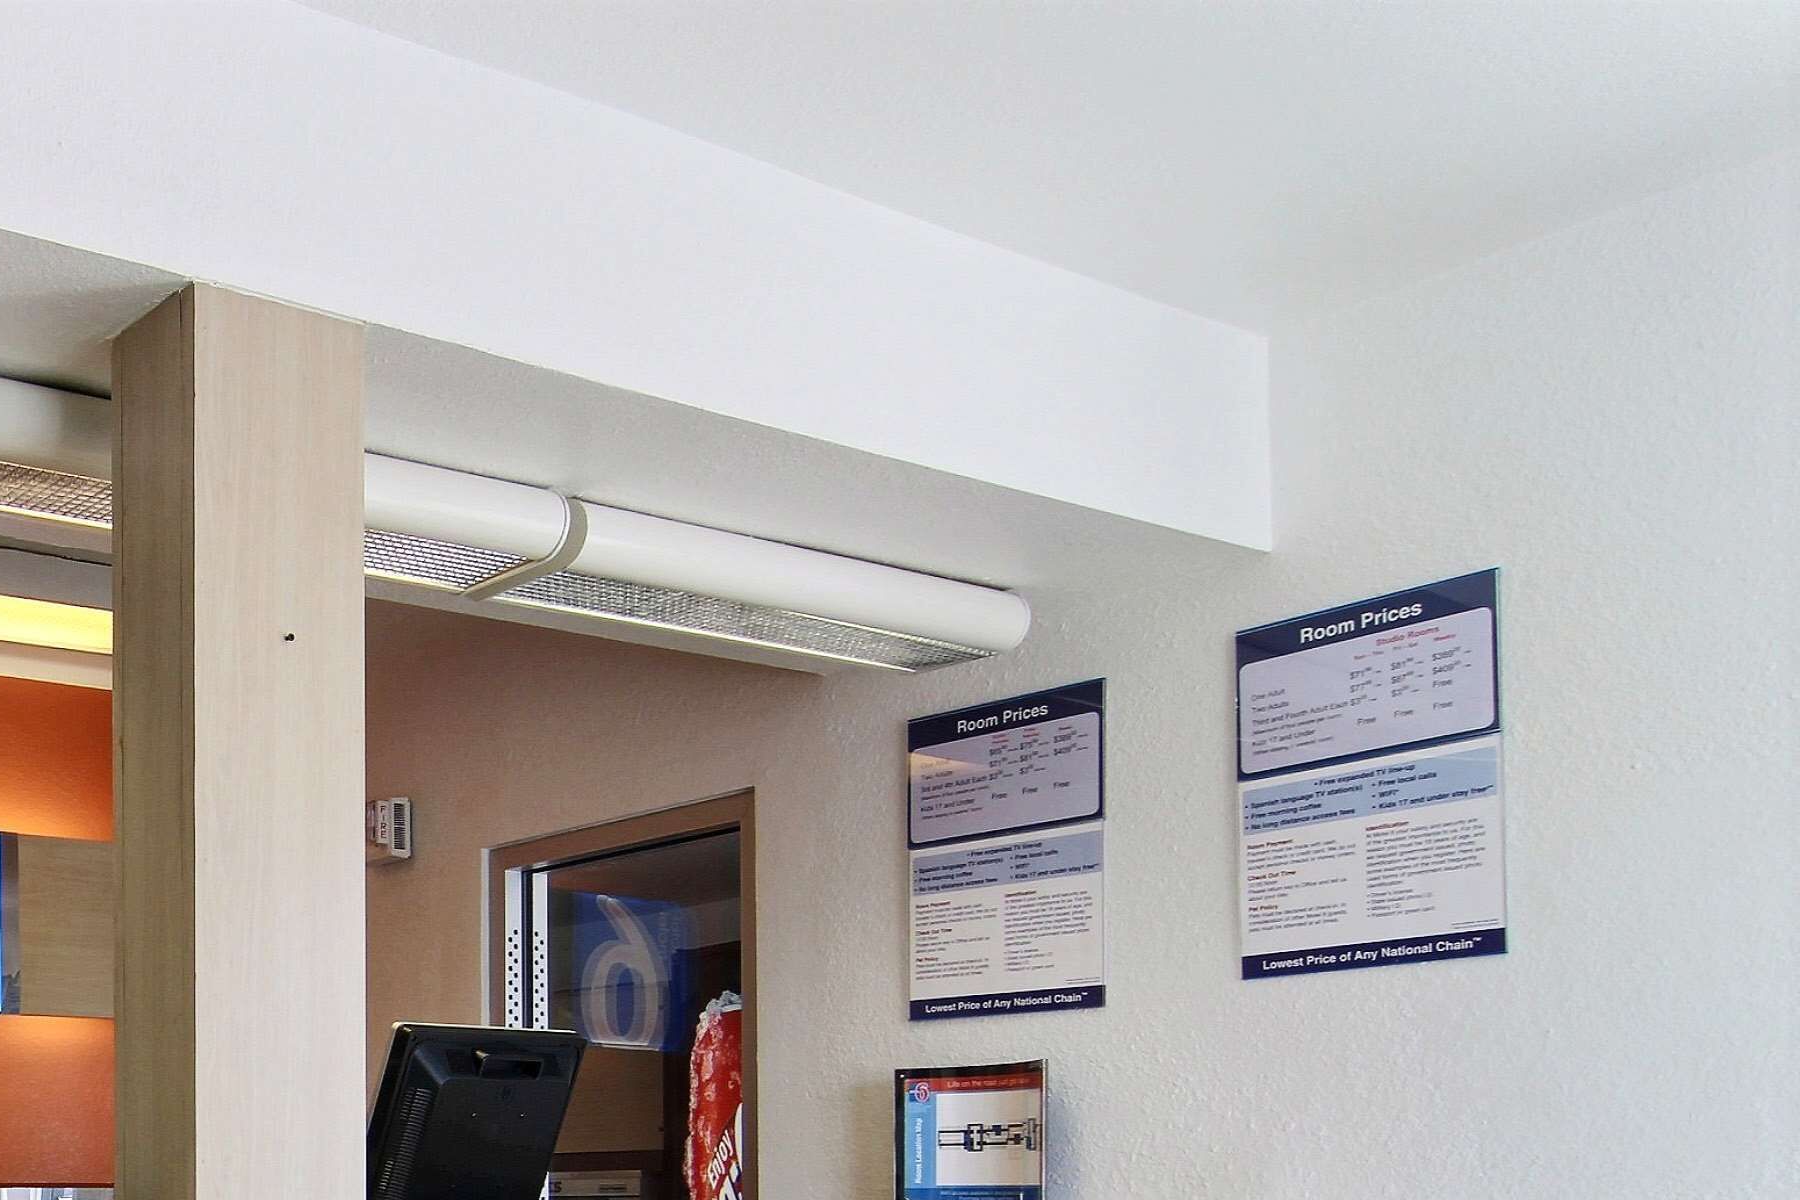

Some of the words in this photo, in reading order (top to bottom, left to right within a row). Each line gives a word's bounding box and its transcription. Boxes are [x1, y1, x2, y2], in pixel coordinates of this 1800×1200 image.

[1300, 621, 1355, 644] Room
[1361, 602, 1423, 629] Prices
[1376, 633, 1405, 646] Studio
[1408, 626, 1440, 639] Rooms
[1432, 679, 1453, 688] Free
[1394, 709, 1414, 718] Free
[1433, 701, 1453, 711] Free
[957, 716, 998, 734] Room
[1002, 704, 1049, 723] Prices
[1252, 717, 1269, 727] Third
[1271, 714, 1284, 722] and
[1285, 709, 1308, 720] Fourth
[1357, 717, 1377, 726] Free
[1279, 734, 1292, 742] and
[1294, 729, 1316, 739] Under
[1338, 771, 1375, 783] expanded
[1397, 775, 1417, 784] local
[1418, 772, 1438, 780] calls
[1251, 799, 1280, 809] Spanish
[1280, 793, 1314, 804] language
[1315, 790, 1326, 798] TV
[1378, 801, 1397, 809] Kids
[1399, 798, 1409, 806] 17
[1427, 792, 1451, 801] under
[1451, 790, 1469, 798] stay
[1251, 812, 1266, 820] Free
[1299, 803, 1322, 812] coffee
[1262, 821, 1279, 829] long
[1280, 816, 1311, 826] distance
[1312, 811, 1338, 821] access
[379, 805, 387, 839] FIRE
[1262, 957, 1304, 971] Lowest
[1306, 954, 1337, 966] Price
[1339, 951, 1352, 963] of
[1353, 949, 1378, 962] Any
[1380, 942, 1433, 959] National
[925, 1003, 956, 1013] Lowest
[957, 1001, 981, 1011] Price
[982, 1000, 992, 1009] of
[993, 999, 1011, 1009] Any
[1013, 995, 1052, 1007] National
[708, 1129, 733, 1191] Enjoy
